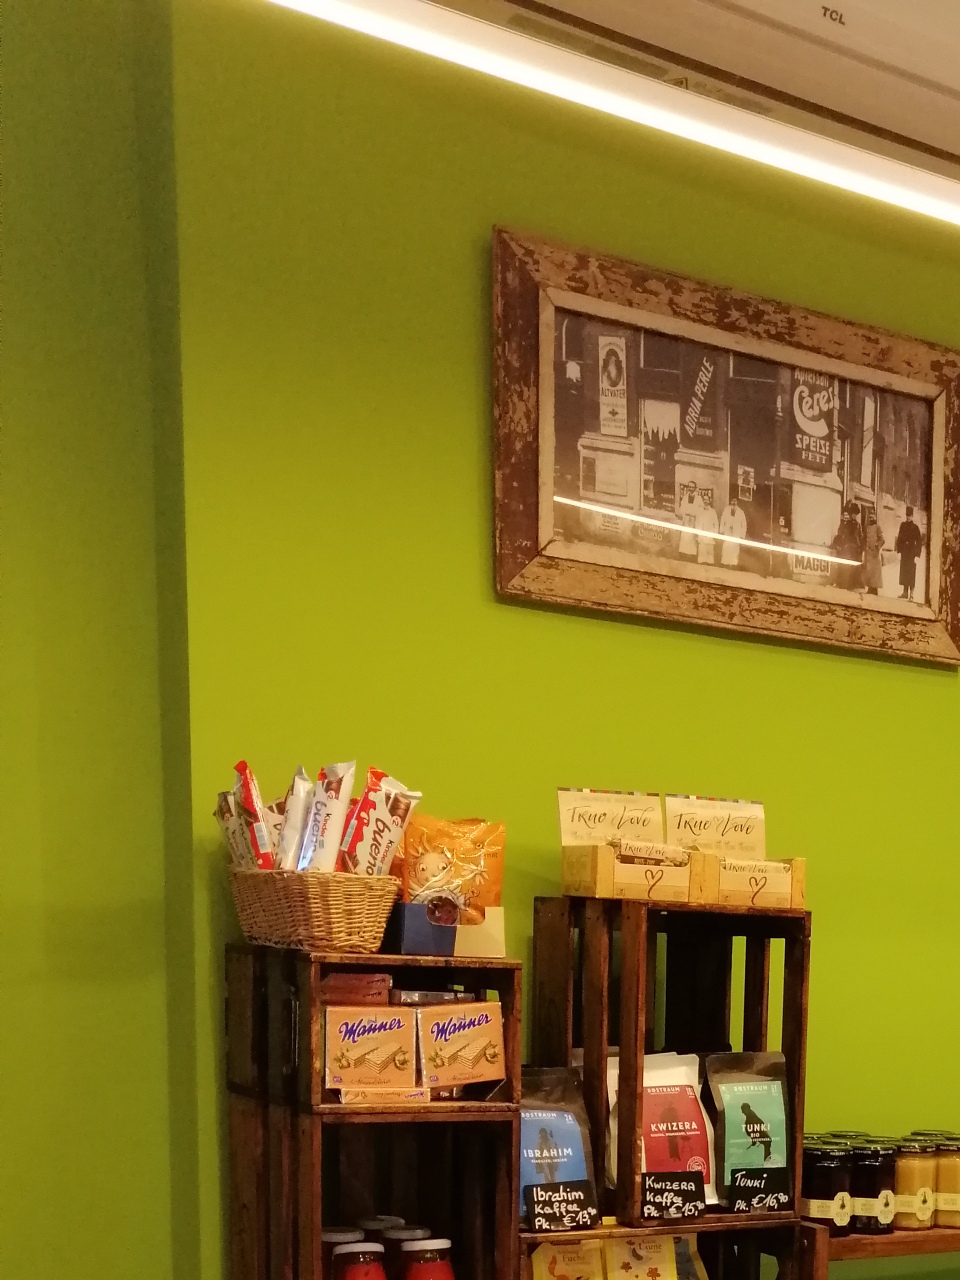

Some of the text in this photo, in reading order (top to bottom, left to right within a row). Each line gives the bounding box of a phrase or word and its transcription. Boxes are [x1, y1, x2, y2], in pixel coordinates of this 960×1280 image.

[821, 5, 846, 26] TCL
[600, 386, 626, 399] ALTVATER
[795, 433, 830, 455] SPEISE
[801, 449, 827, 464] FETT
[794, 554, 830, 574] MAGGI
[365, 817, 392, 876] bueno
[338, 1017, 405, 1044] Manner
[430, 1012, 493, 1043] Manner
[650, 1121, 698, 1132] KWIZERA
[741, 1123, 770, 1132] TUNKI
[523, 1147, 573, 1158] IBRAHIM
[533, 1185, 584, 1202] Ibrahim
[646, 1191, 683, 1207] Kaffee
[534, 1202, 580, 1217] Kaffee
